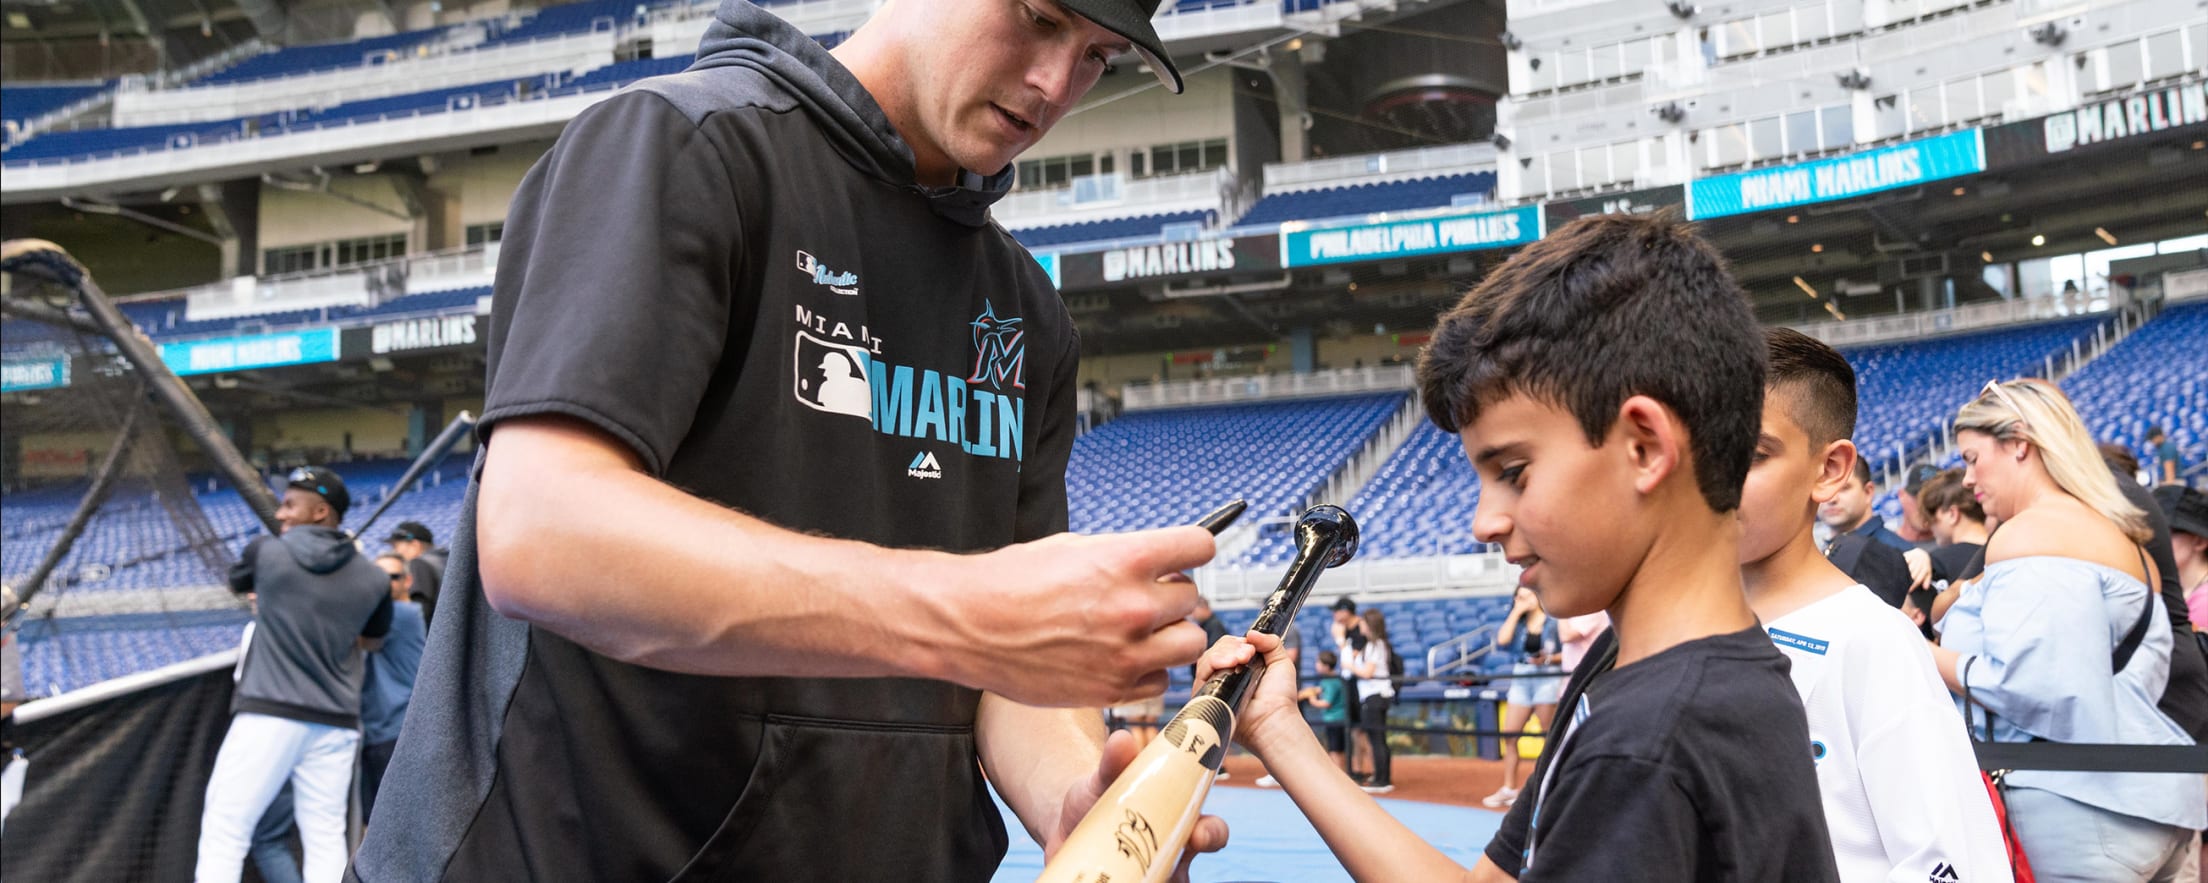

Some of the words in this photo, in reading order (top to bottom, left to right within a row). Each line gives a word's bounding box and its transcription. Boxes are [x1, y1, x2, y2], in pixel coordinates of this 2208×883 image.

[2044, 81, 2208, 153] @MARLIN
[1741, 169, 1811, 209] MIAMI
[1815, 147, 1921, 198] MARLINS
[1310, 222, 1437, 259] PHILADELPHIA
[1439, 213, 1520, 247] PHILLIES
[1103, 239, 1235, 282] @MARLINS
[372, 314, 477, 354] @MARLINS
[908, 468, 942, 480] Majestic
